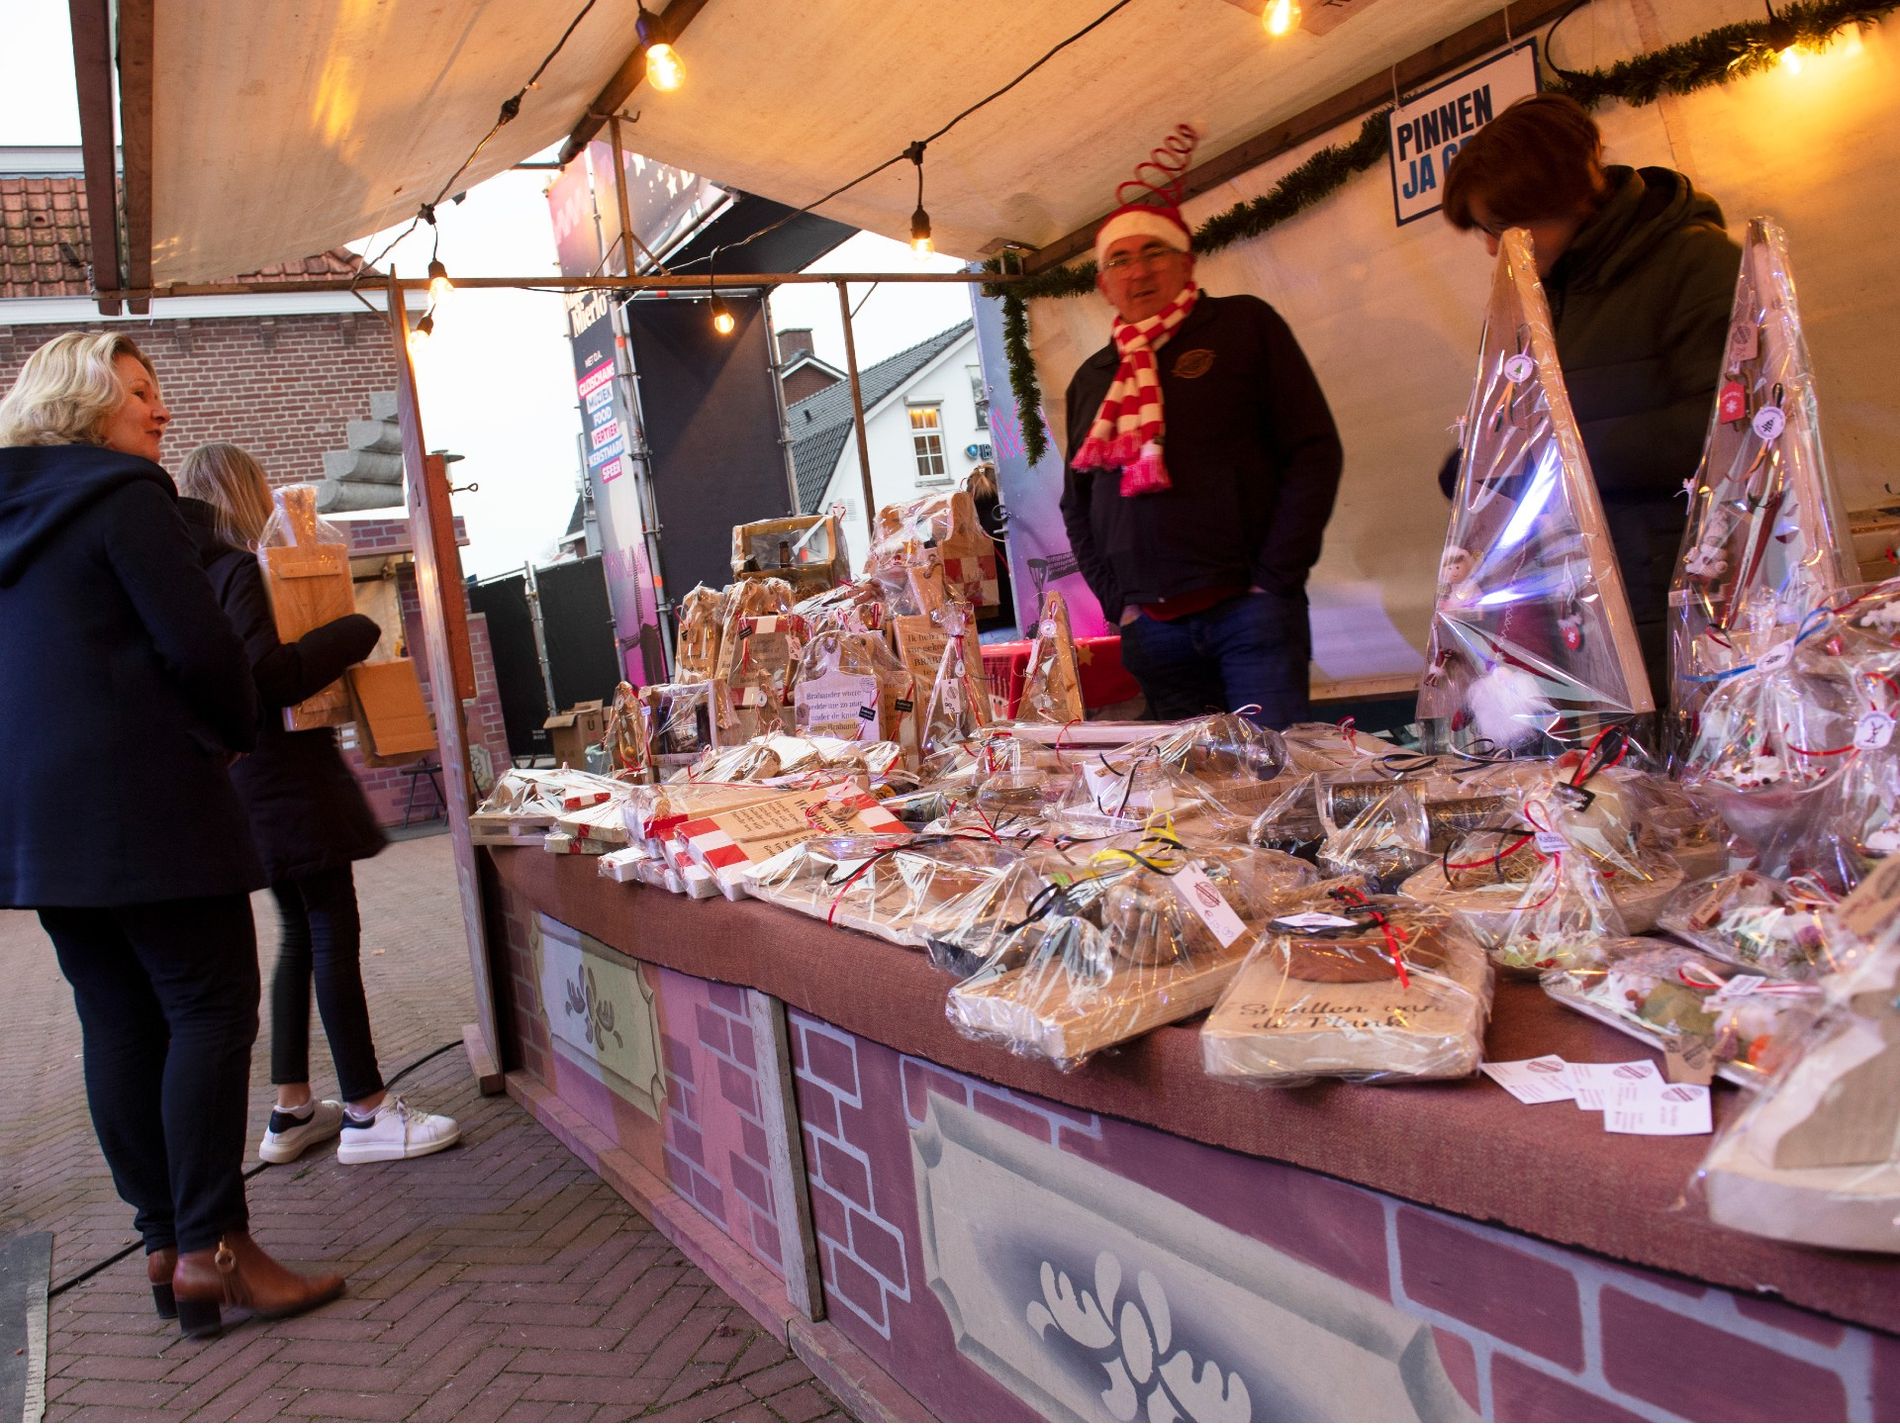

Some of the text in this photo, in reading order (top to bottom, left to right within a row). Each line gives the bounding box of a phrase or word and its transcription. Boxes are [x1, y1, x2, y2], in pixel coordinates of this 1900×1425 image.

[1397, 84, 1493, 162] PINNEN
[1402, 153, 1436, 199] JA
[1240, 1001, 1369, 1016] Smullen
